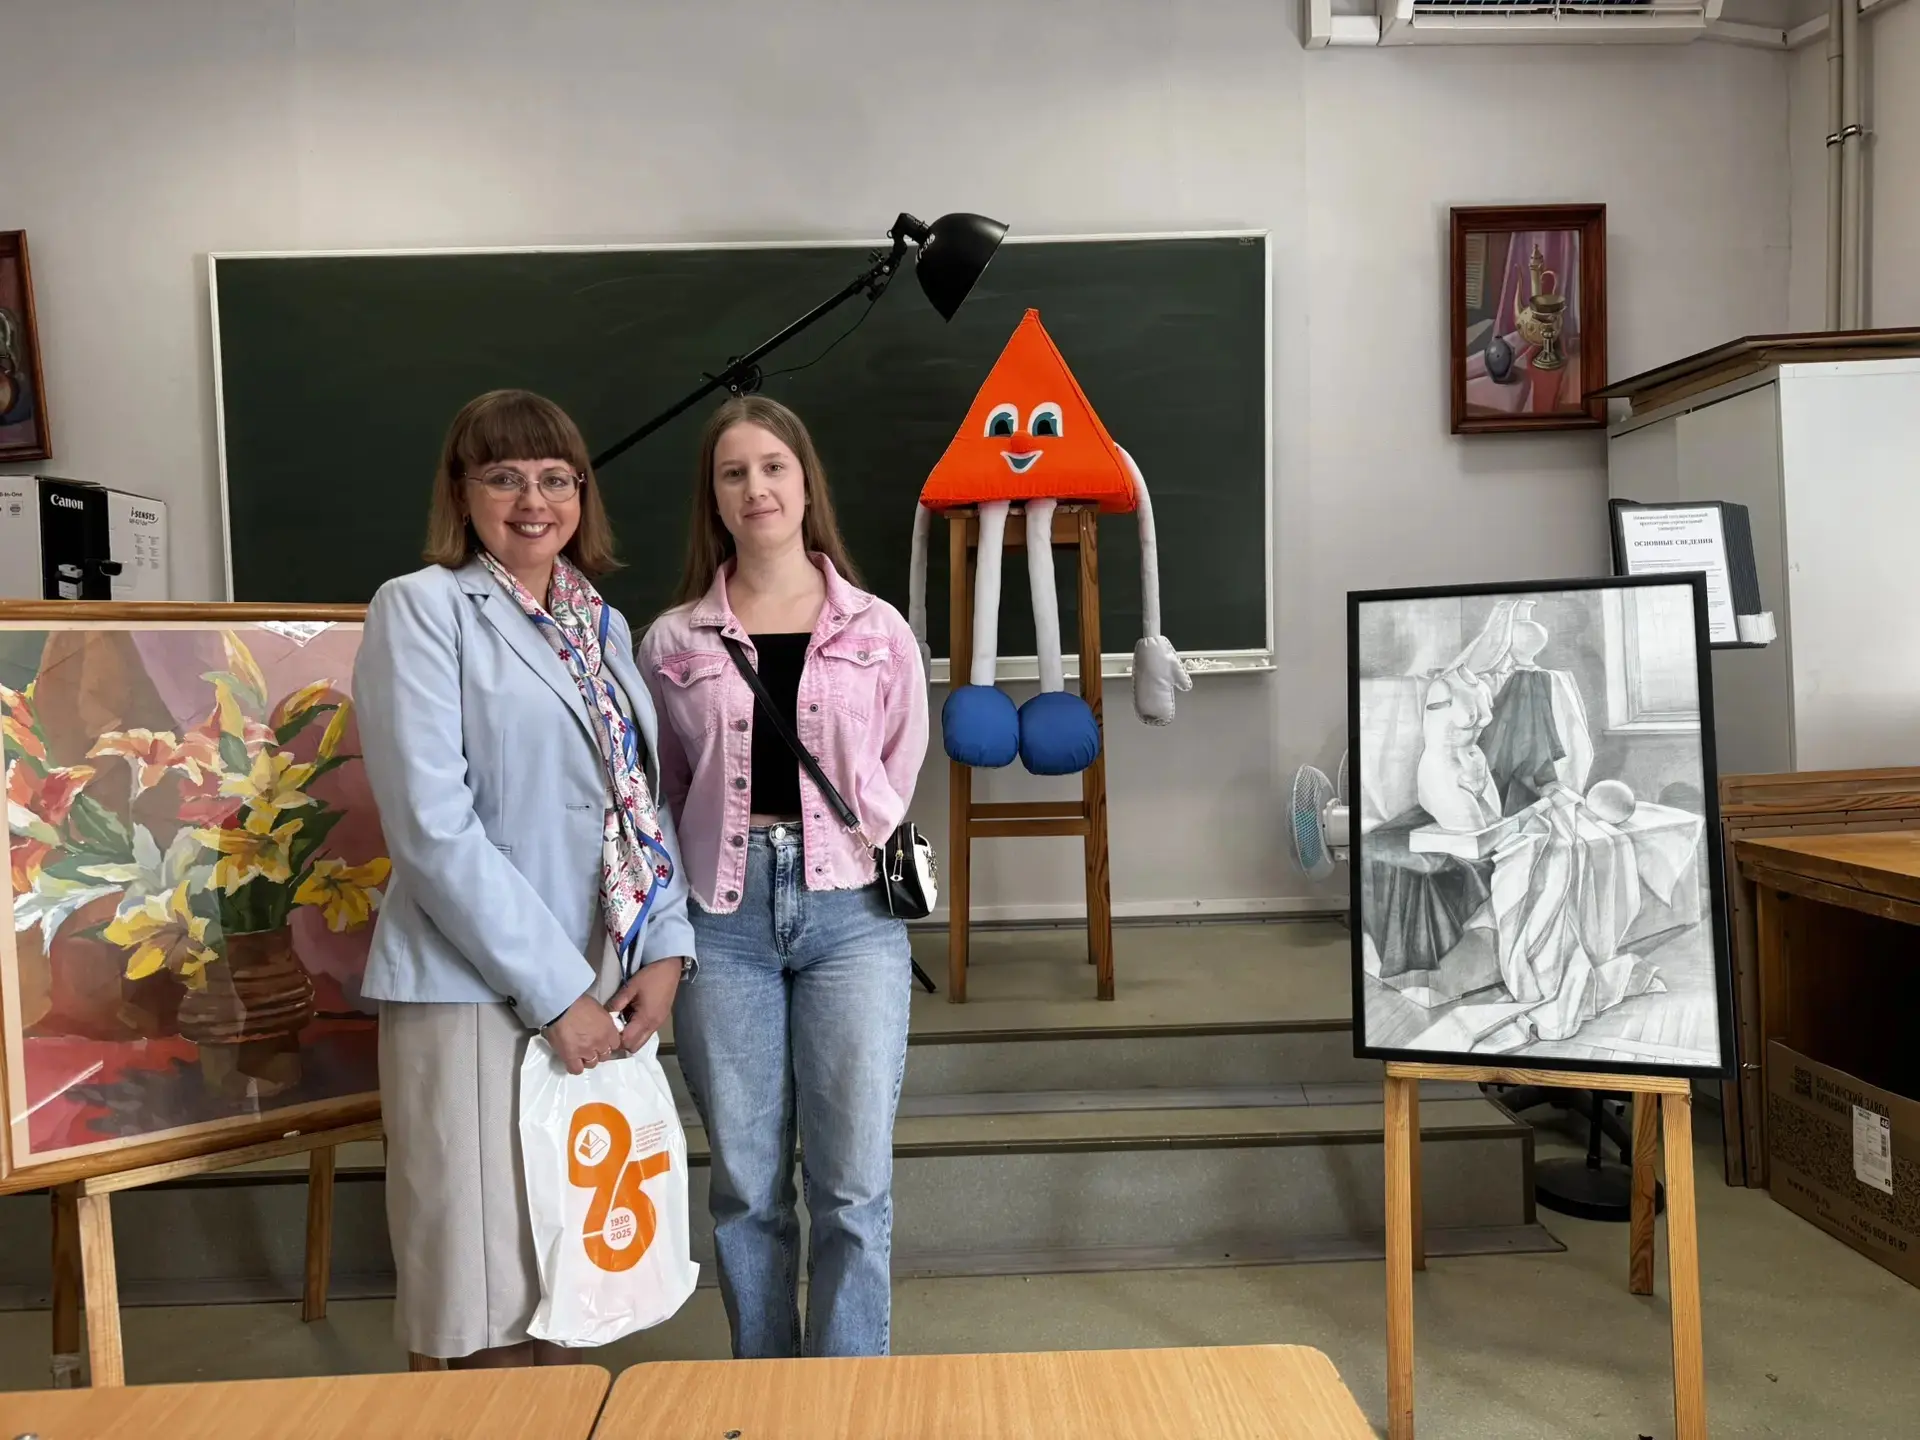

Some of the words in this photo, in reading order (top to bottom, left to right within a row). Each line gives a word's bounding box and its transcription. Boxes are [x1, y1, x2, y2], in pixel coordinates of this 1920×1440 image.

[50, 493, 84, 510] Canon
[131, 506, 156, 521] i-SENSYS
[1634, 539, 1673, 547] ОСНОВНЫЕ
[1675, 538, 1713, 546] СВЕДЕНИЯ
[1865, 1097, 1890, 1118] ЗАВОД
[1881, 1118, 1889, 1128] 46
[611, 1215, 630, 1227] 1930
[610, 1228, 631, 1241] 2025
